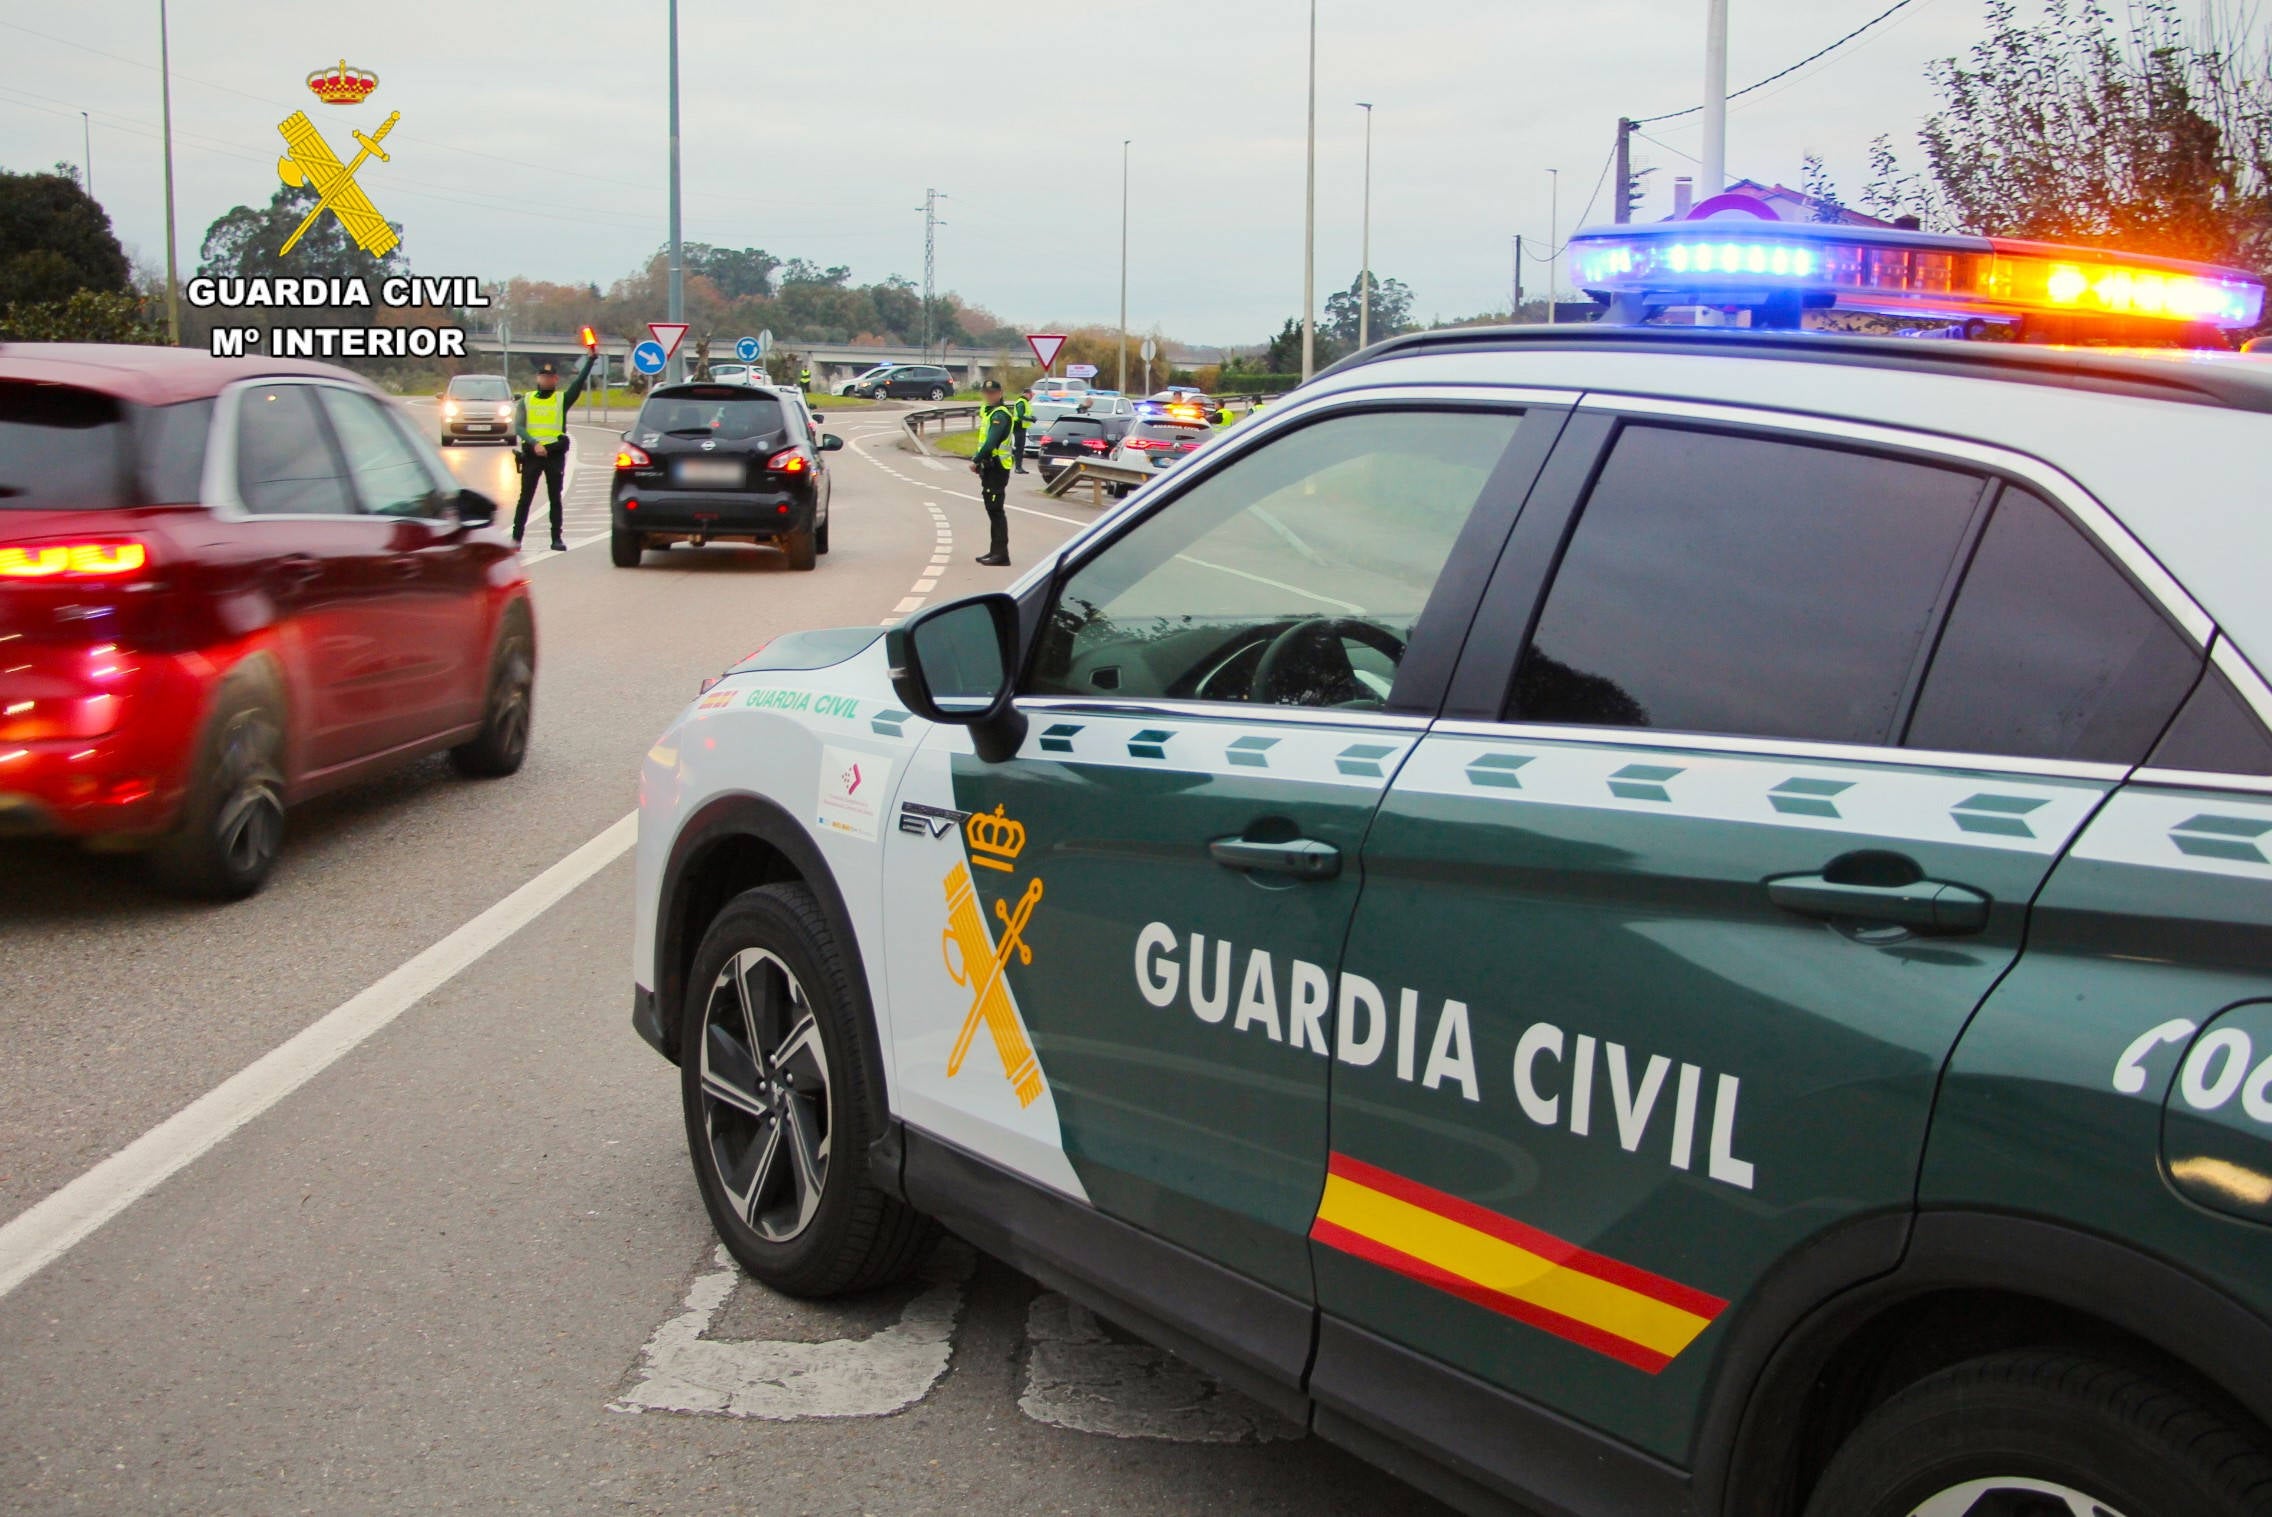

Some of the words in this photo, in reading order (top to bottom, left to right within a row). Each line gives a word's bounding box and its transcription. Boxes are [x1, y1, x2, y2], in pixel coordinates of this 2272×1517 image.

[745, 689, 812, 711] GUARDIA
[814, 694, 860, 719] CIVIL
[900, 812, 956, 839] EV
[1135, 922, 1479, 1102] GUARDIA
[1513, 1022, 1754, 1190] CIVIL
